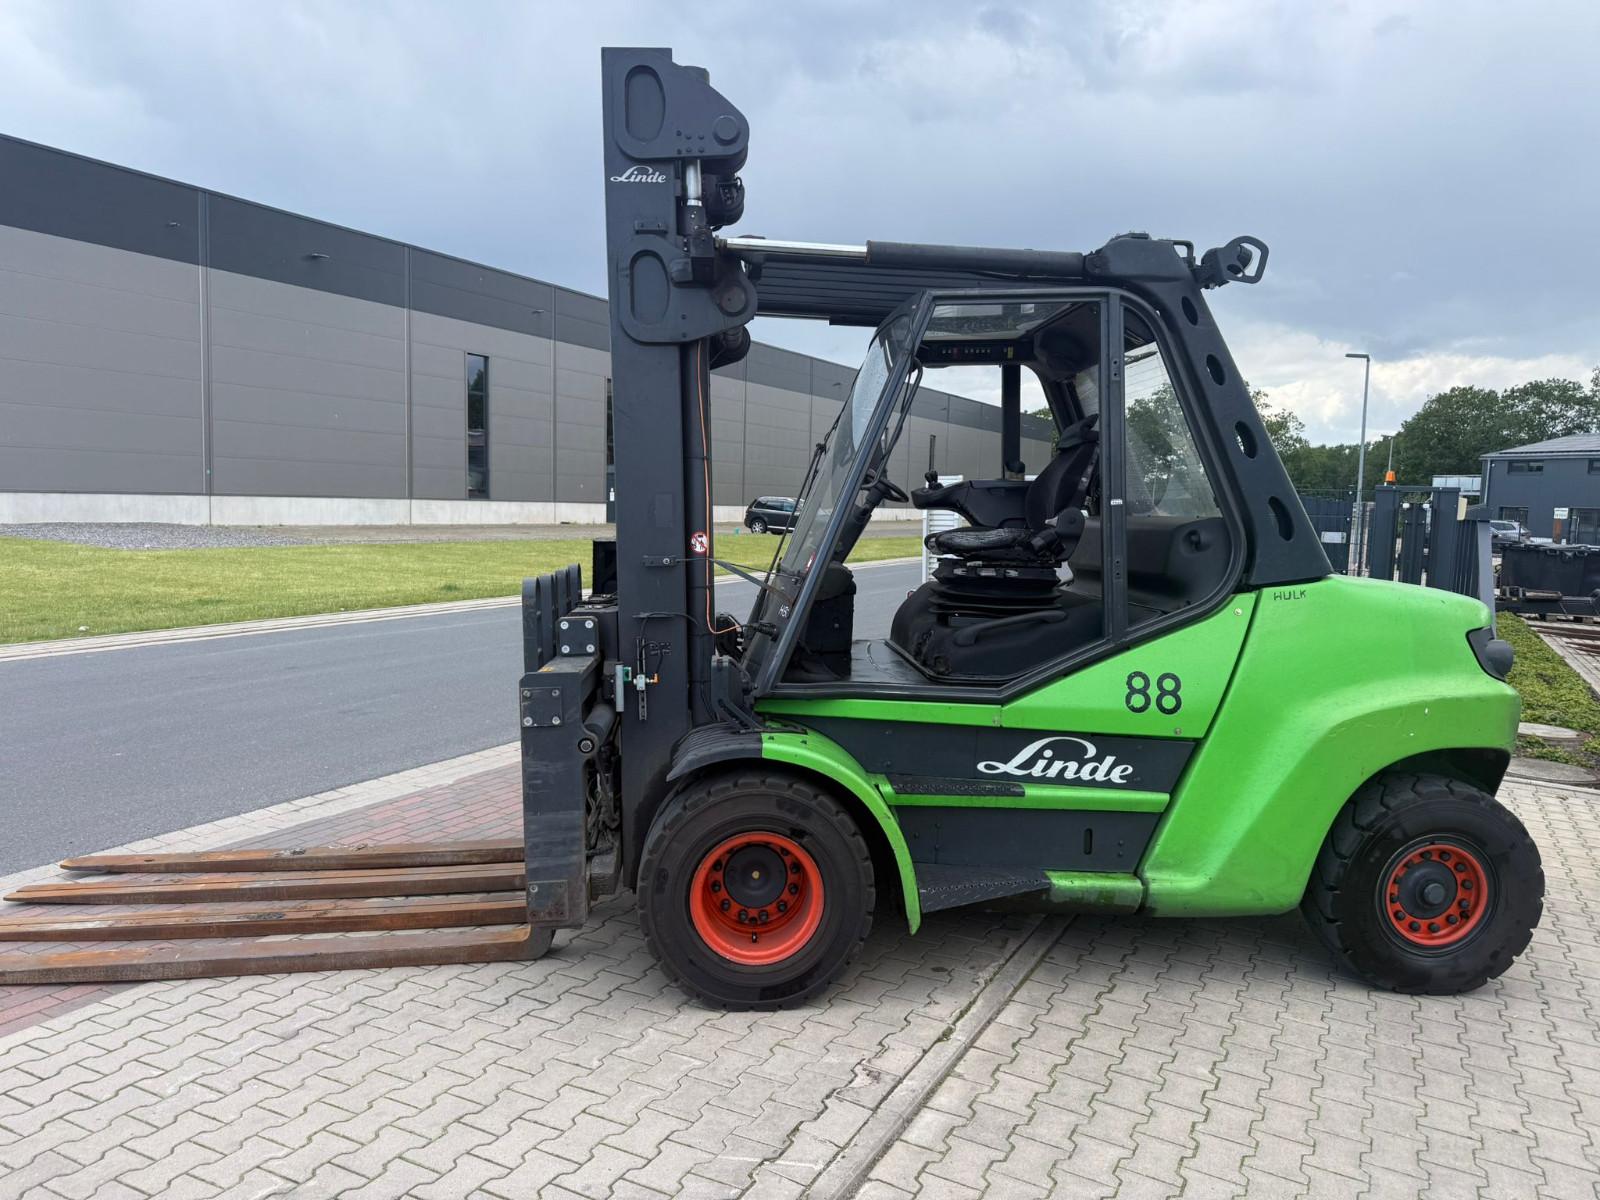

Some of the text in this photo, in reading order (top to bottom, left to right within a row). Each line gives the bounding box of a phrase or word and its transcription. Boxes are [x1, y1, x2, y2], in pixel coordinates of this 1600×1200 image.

[610, 165, 666, 183] Linde
[1273, 589, 1306, 601] HULK
[1125, 671, 1182, 715] 88
[976, 736, 1133, 784] Linde
